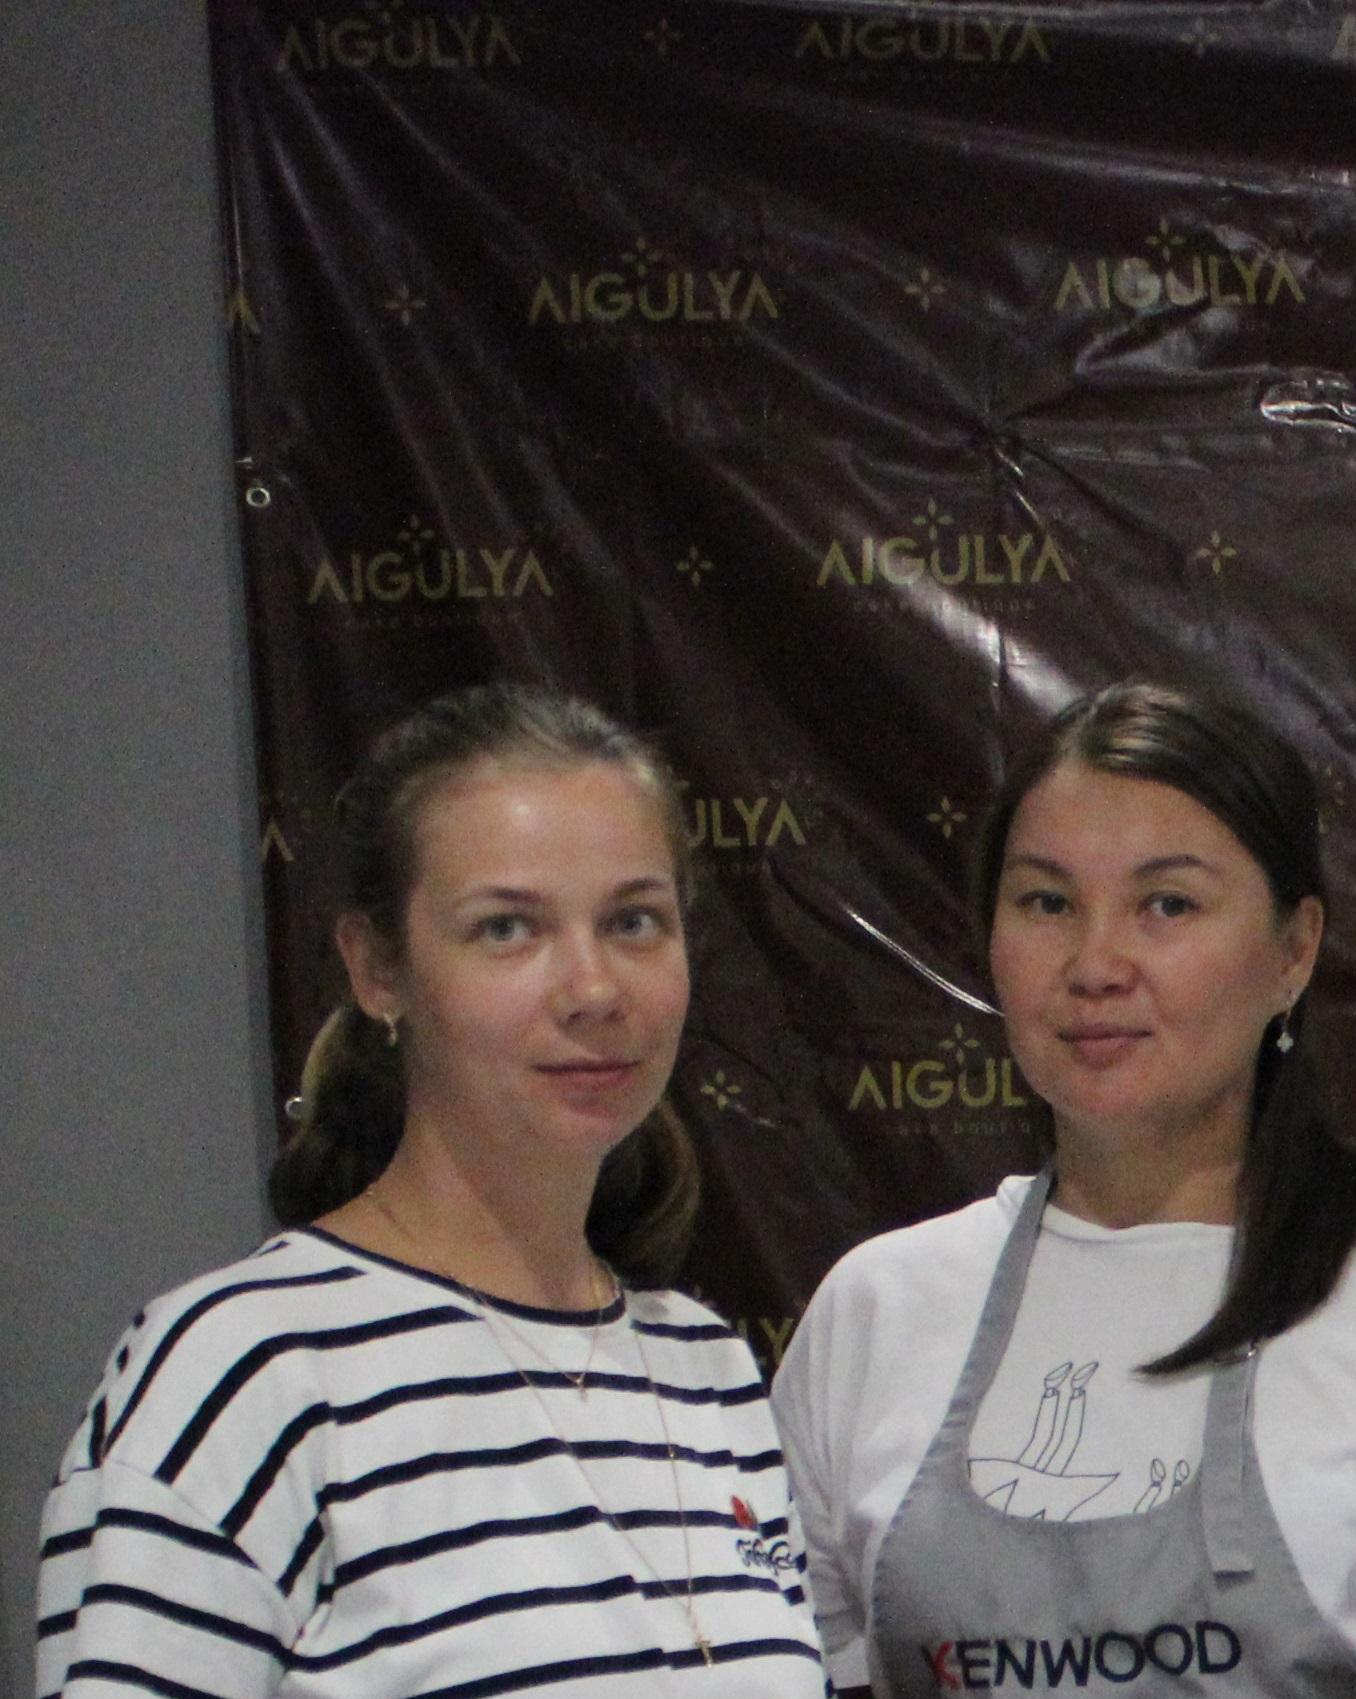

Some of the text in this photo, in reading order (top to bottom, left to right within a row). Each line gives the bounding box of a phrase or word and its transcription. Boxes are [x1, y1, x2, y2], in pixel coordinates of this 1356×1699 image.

[277, 15, 522, 71] AIGULYA
[796, 15, 1051, 63] AIGULYA
[528, 269, 779, 325] AIGULYA
[307, 548, 554, 604] AIGULYA
[816, 532, 1071, 587] AIGULYA
[848, 1057, 1028, 1111] AIGUL
[921, 1620, 1242, 1690] KENWOOD
